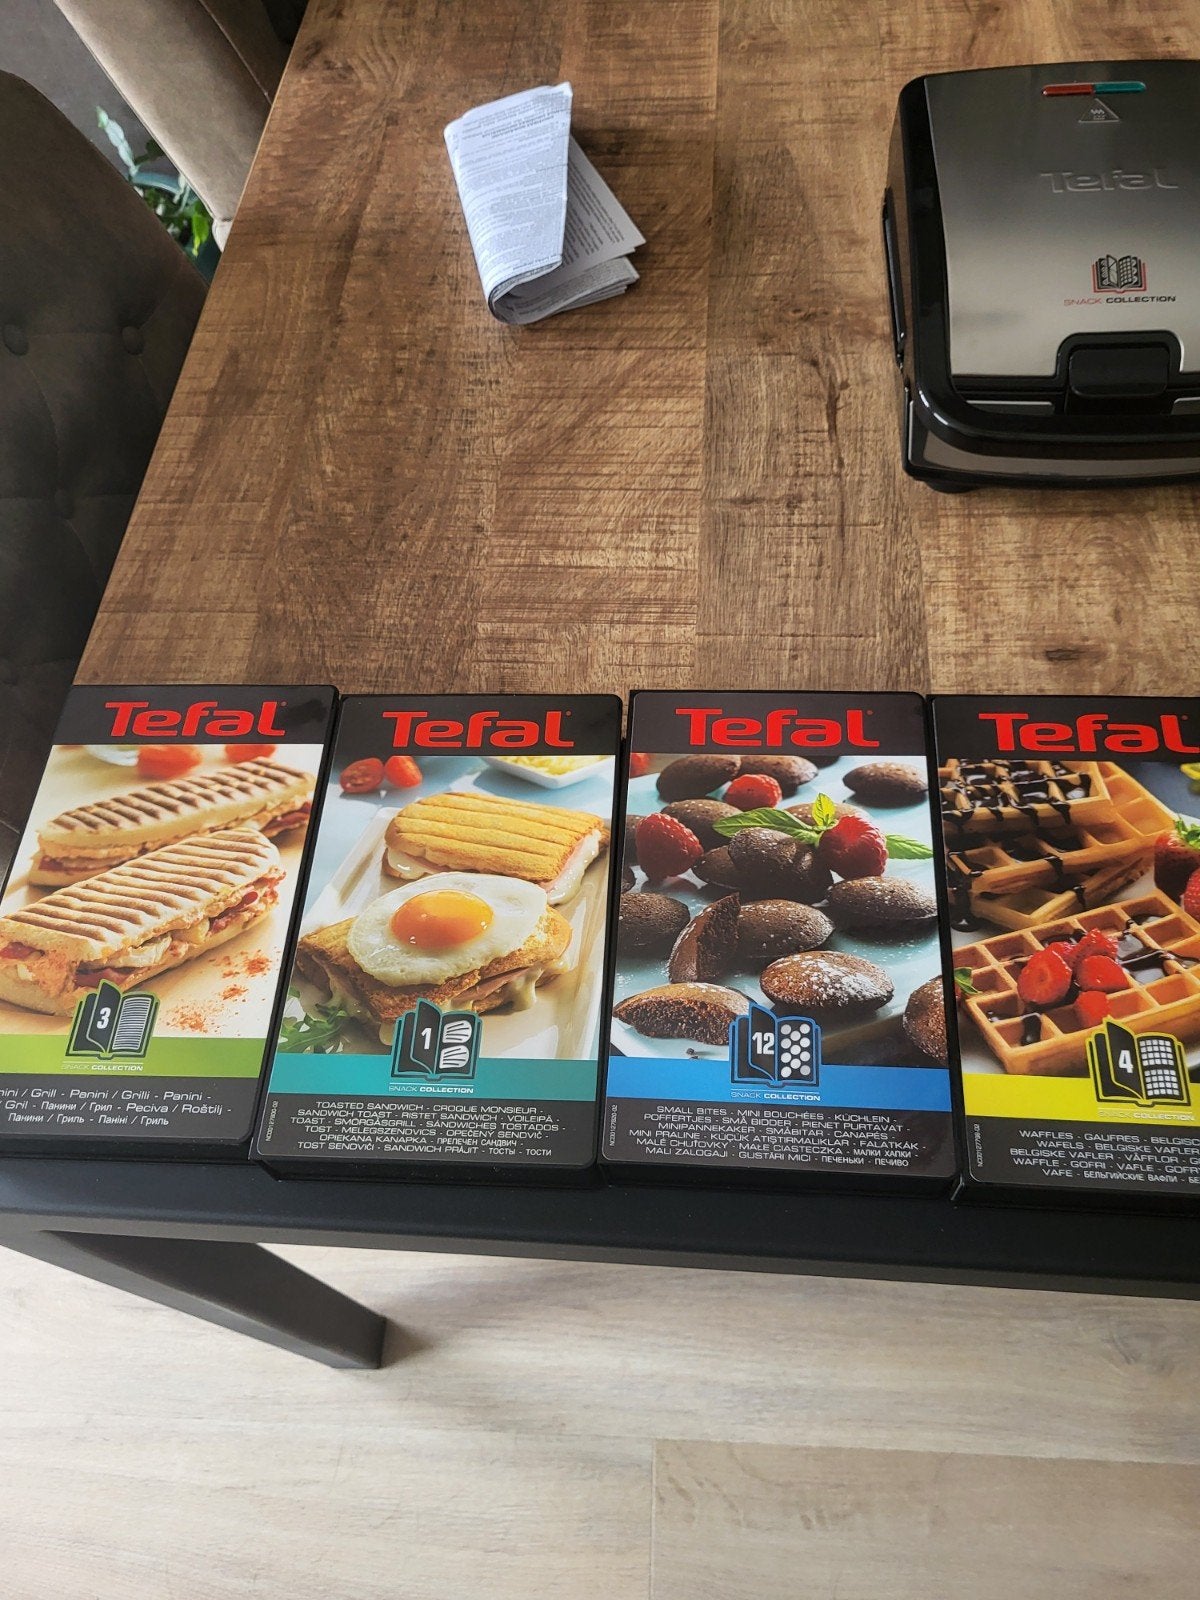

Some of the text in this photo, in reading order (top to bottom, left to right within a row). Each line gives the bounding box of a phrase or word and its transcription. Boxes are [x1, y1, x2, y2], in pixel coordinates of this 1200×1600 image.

[1041, 168, 1179, 193] Tefal
[1064, 296, 1176, 306] SNACK COLLECTION
[105, 701, 286, 737] Tefal
[382, 711, 574, 748] Tefal
[675, 708, 880, 747] Tefal
[978, 712, 1200, 753] Tefal
[97, 1007, 110, 1029] 3
[421, 1028, 432, 1050] 1
[752, 1032, 774, 1055] 12
[1118, 1050, 1133, 1073] 4
[31, 1089, 57, 1098] Grill
[70, 1089, 108, 1099] Panini
[121, 1090, 150, 1100] Grilli
[163, 1091, 203, 1101] Panini
[419, 1086, 474, 1094] COLLECTION
[764, 1093, 821, 1101] COLLECTION
[5, 1100, 223, 1116] Gril Панини Грил Peciva Roštilj
[316, 1101, 537, 1114] TOASTED SANDWICH CROQUE MONSIEUR
[657, 1105, 693, 1115] SMALL
[697, 1107, 727, 1116] BITES
[737, 1109, 760, 1117] MINI
[763, 1110, 824, 1120] BOUCHÉES
[8, 1112, 169, 1126] Панини Гриль Паніні Гриль
[297, 1109, 354, 1118] SANDWICH
[357, 1111, 392, 1119] TOAST
[401, 1112, 436, 1120] RISTET
[440, 1113, 498, 1121] SANDWICH
[1134, 1113, 1195, 1121] COLLECTION
[501, 1123, 559, 1131] TOSTADOS
[643, 1113, 712, 1123] POFFERTJES
[751, 1119, 791, 1127] BIDDER
[801, 1121, 840, 1129] PIENET
[843, 1123, 903, 1132] PURTAVAT
[658, 1122, 756, 1134] MINIPANNEKAKER
[765, 1126, 824, 1137] SMÅBITAR
[305, 1125, 332, 1133] TOST
[341, 1127, 436, 1136] MELEGSZENDVICS
[629, 1129, 652, 1137] MINI
[655, 1130, 700, 1140] PRALINE
[1019, 1130, 1073, 1140] WAFFLES
[1084, 1133, 1140, 1143] GAUFRES
[319, 1134, 517, 1147] OPIEKANA KANAPKA ПРЕПЕЧЕН САНДВИЧ
[1036, 1140, 1200, 1155] WAFELS BELGISKE VAFLER
[384, 1144, 441, 1153] SANDWICH
[773, 1145, 843, 1154] CIASTECZKA
[853, 1148, 881, 1156] МАЛКИ
[884, 1150, 912, 1158] ХАПКИ
[1009, 1148, 1066, 1158] BELGISKE
[1068, 1151, 1114, 1160] VAFLER
[645, 1147, 672, 1155] MALI
[675, 1148, 728, 1158] ZALOGAJI
[788, 1153, 811, 1162] MICI
[821, 1155, 864, 1165] ПЕЧЕНЬКИ
[874, 1158, 909, 1167] ПЕЧИВО
[1013, 1157, 1060, 1167] WAFFLE
[1070, 1160, 1106, 1169] GOFRI
[1116, 1163, 1154, 1172] VAFLE
[1042, 1168, 1073, 1177] VAFE
